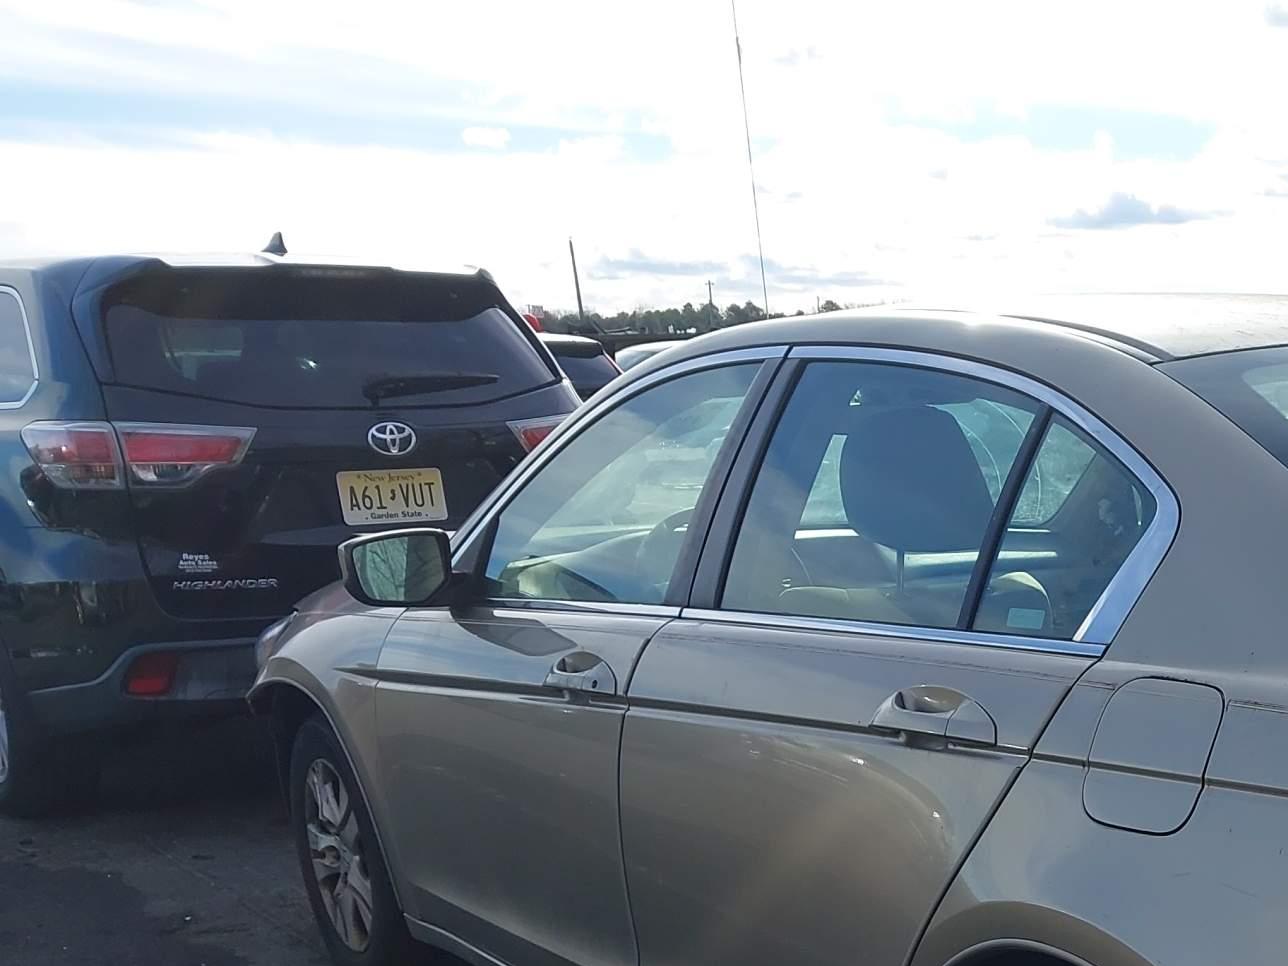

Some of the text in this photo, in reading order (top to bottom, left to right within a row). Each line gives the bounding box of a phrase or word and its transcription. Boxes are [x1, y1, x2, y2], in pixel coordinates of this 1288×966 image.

[363, 473, 385, 482] New
[370, 510, 422, 520] Garden State
[173, 578, 278, 590] HIGHLANDER
